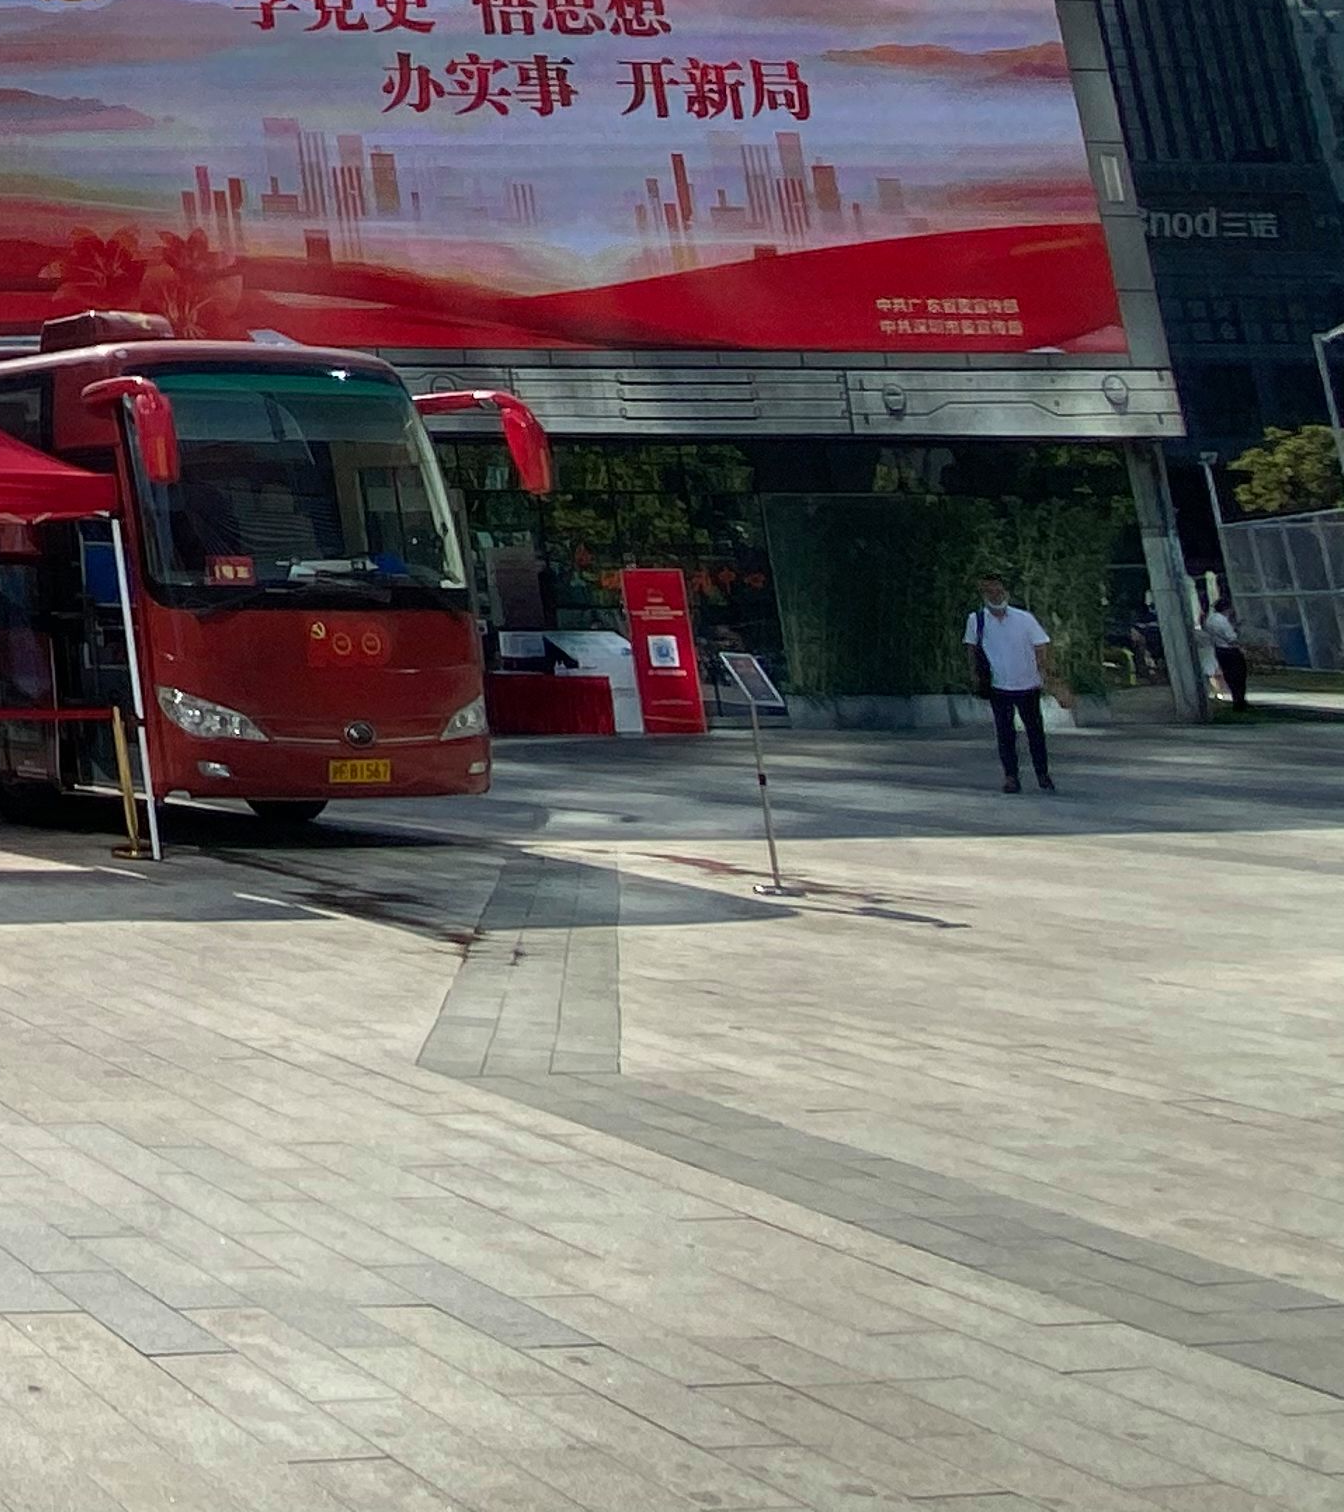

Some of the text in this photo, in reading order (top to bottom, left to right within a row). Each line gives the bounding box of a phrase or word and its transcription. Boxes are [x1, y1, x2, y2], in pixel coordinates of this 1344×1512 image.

[381, 50, 811, 121] 办实事 开新局
